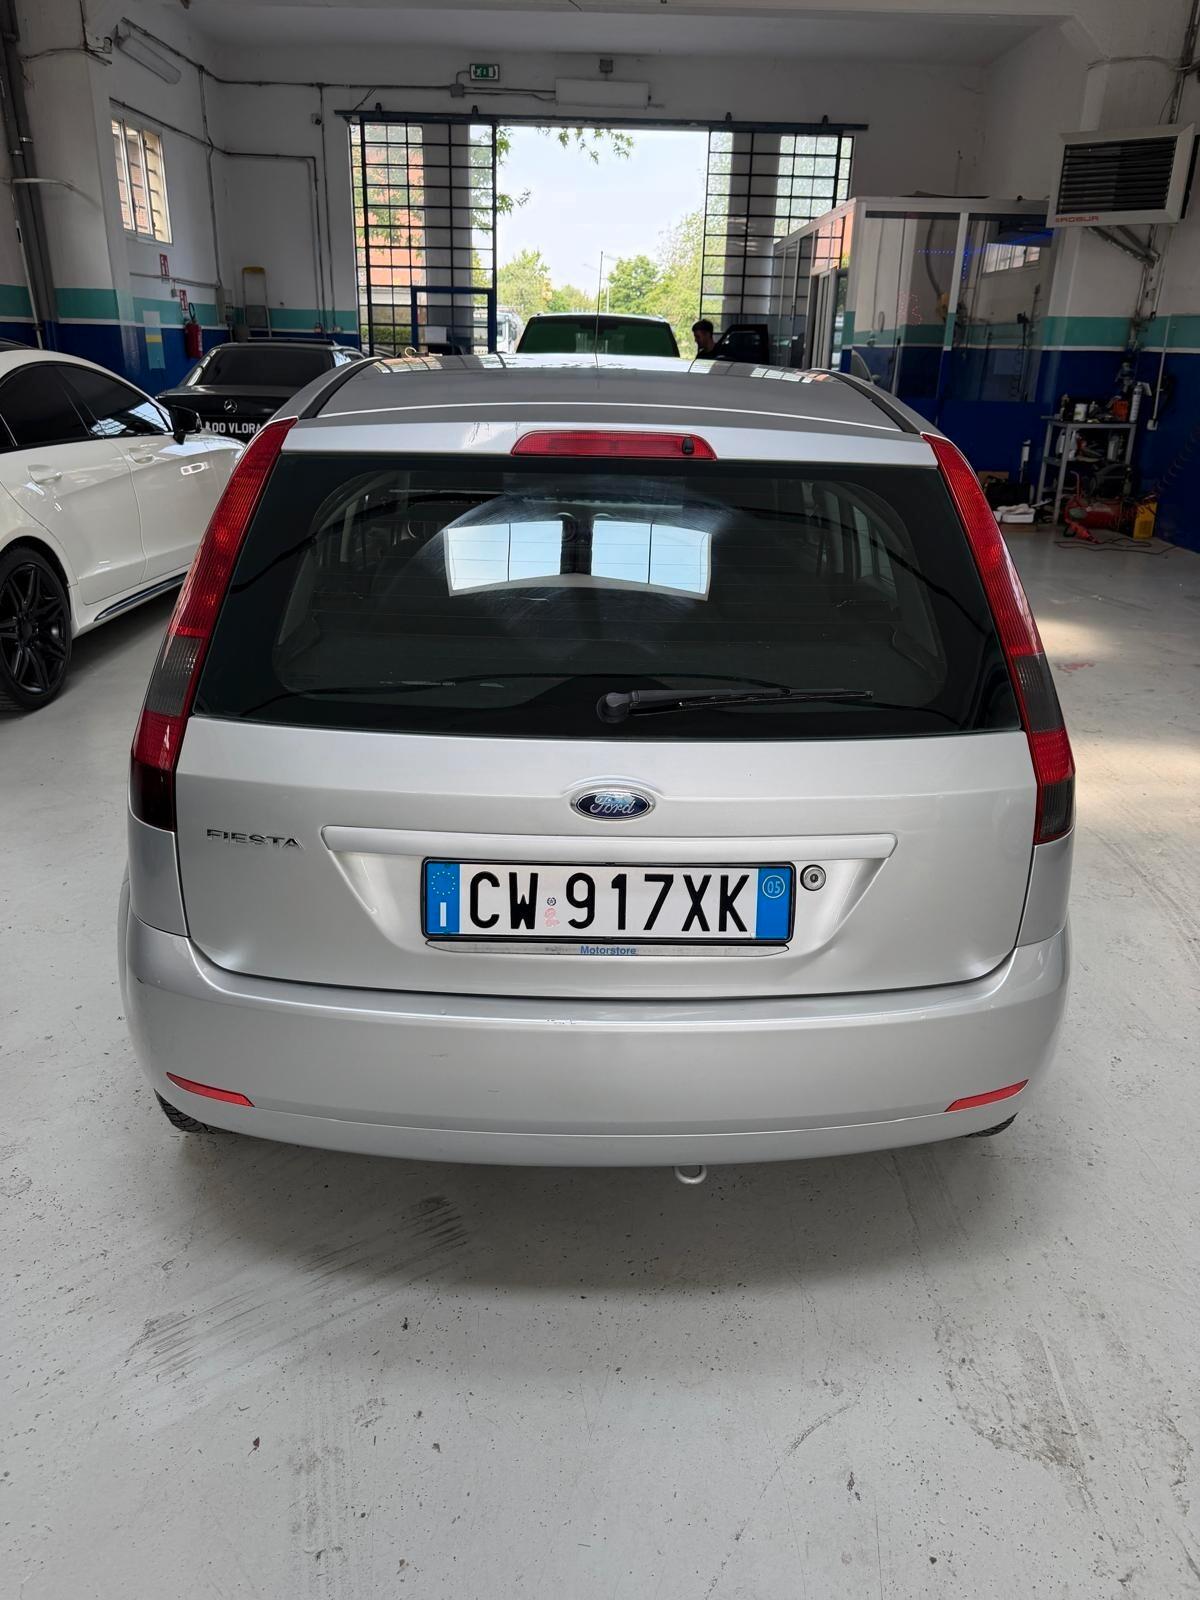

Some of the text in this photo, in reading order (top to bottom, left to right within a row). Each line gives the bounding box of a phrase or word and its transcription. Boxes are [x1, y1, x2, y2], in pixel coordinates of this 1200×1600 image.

[589, 794, 636, 814] Ford
[206, 828, 303, 849] FIESTA
[767, 880, 781, 894] 05
[580, 945, 637, 955] Motorstore
